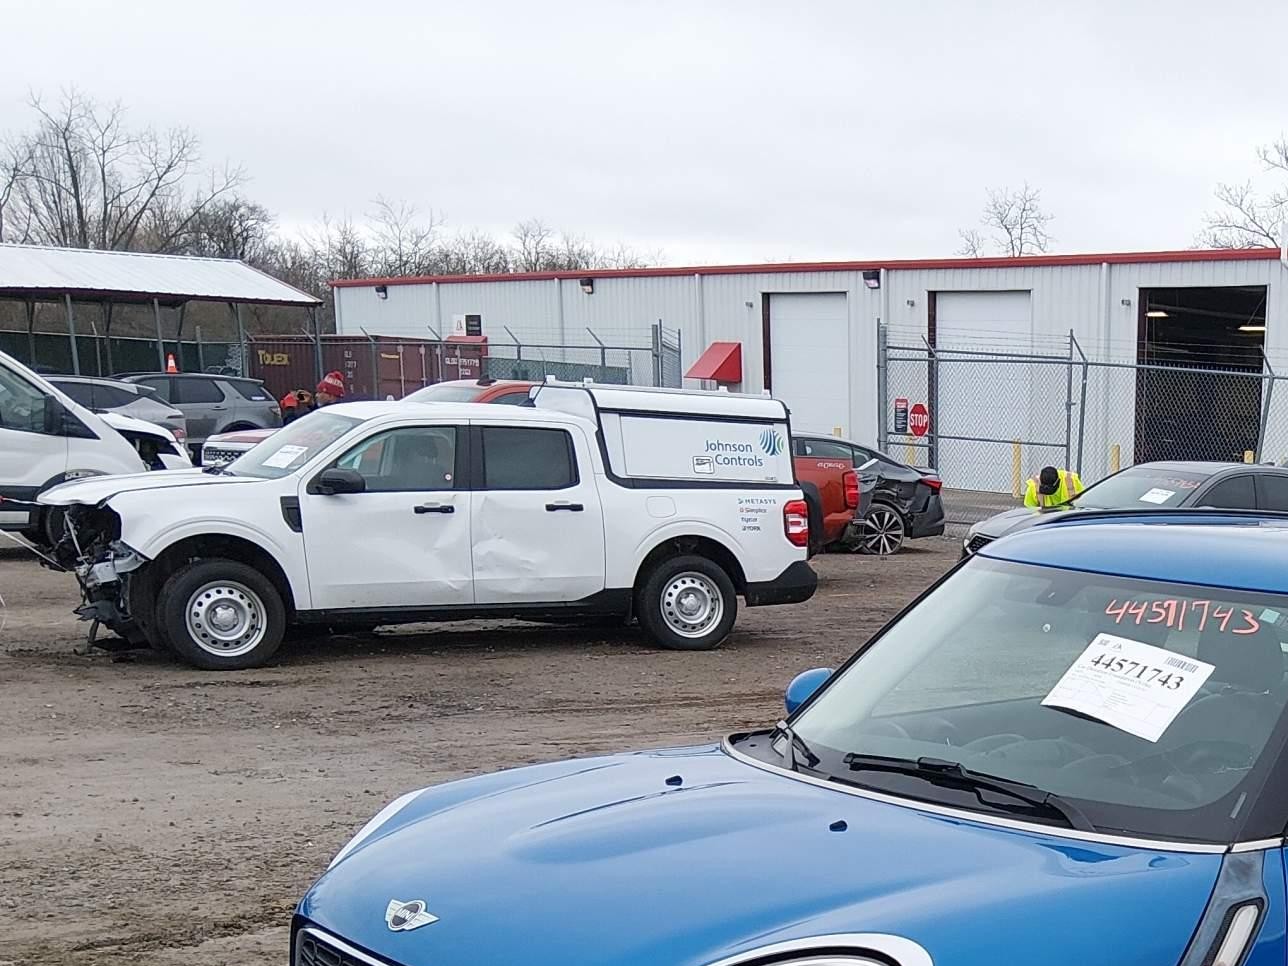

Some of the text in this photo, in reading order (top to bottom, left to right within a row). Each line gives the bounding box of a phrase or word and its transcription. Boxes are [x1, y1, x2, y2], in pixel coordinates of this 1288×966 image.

[910, 414, 928, 427] STOP
[705, 440, 753, 453] Johnson
[715, 454, 764, 467] Controls
[1090, 652, 1185, 691] 44571743
